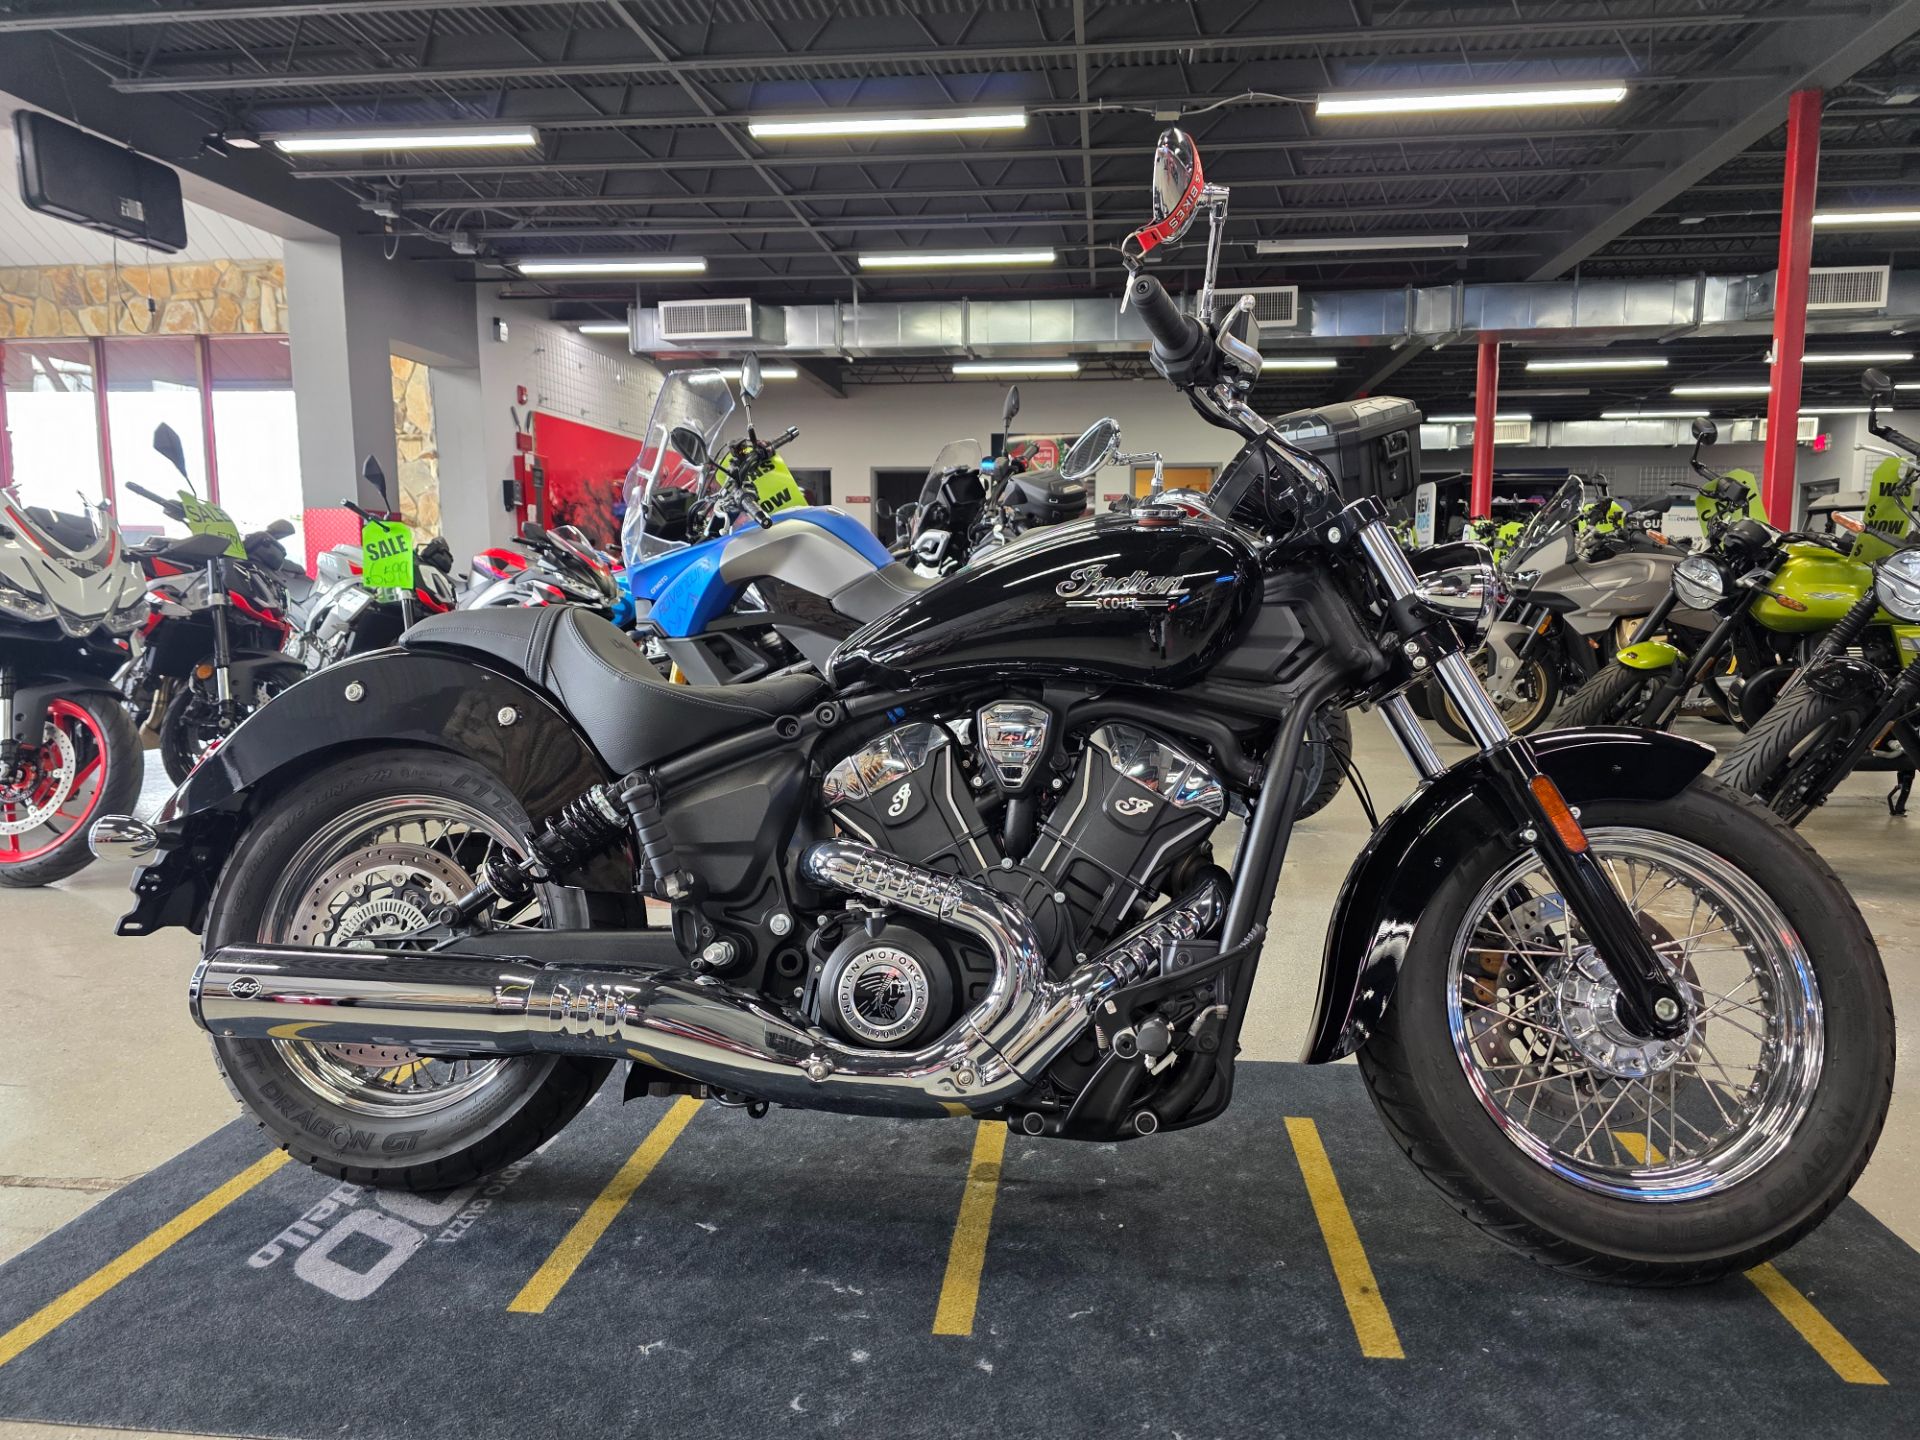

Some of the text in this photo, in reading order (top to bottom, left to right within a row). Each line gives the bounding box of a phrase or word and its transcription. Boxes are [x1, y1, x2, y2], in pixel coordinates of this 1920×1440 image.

[1169, 186, 1199, 228] BIKES
[759, 488, 792, 514] OW
[366, 534, 409, 561] SALE
[56, 557, 104, 572] aprilia
[1056, 563, 1190, 598] Indian
[1095, 597, 1138, 610] SCOUT
[231, 982, 260, 993] S&S
[841, 951, 926, 1023] INDIAN MOTORCYCLE
[866, 1028, 898, 1039] 1901
[259, 1079, 428, 1154] DRAGON GT
[435, 1199, 492, 1242] GUZZI
